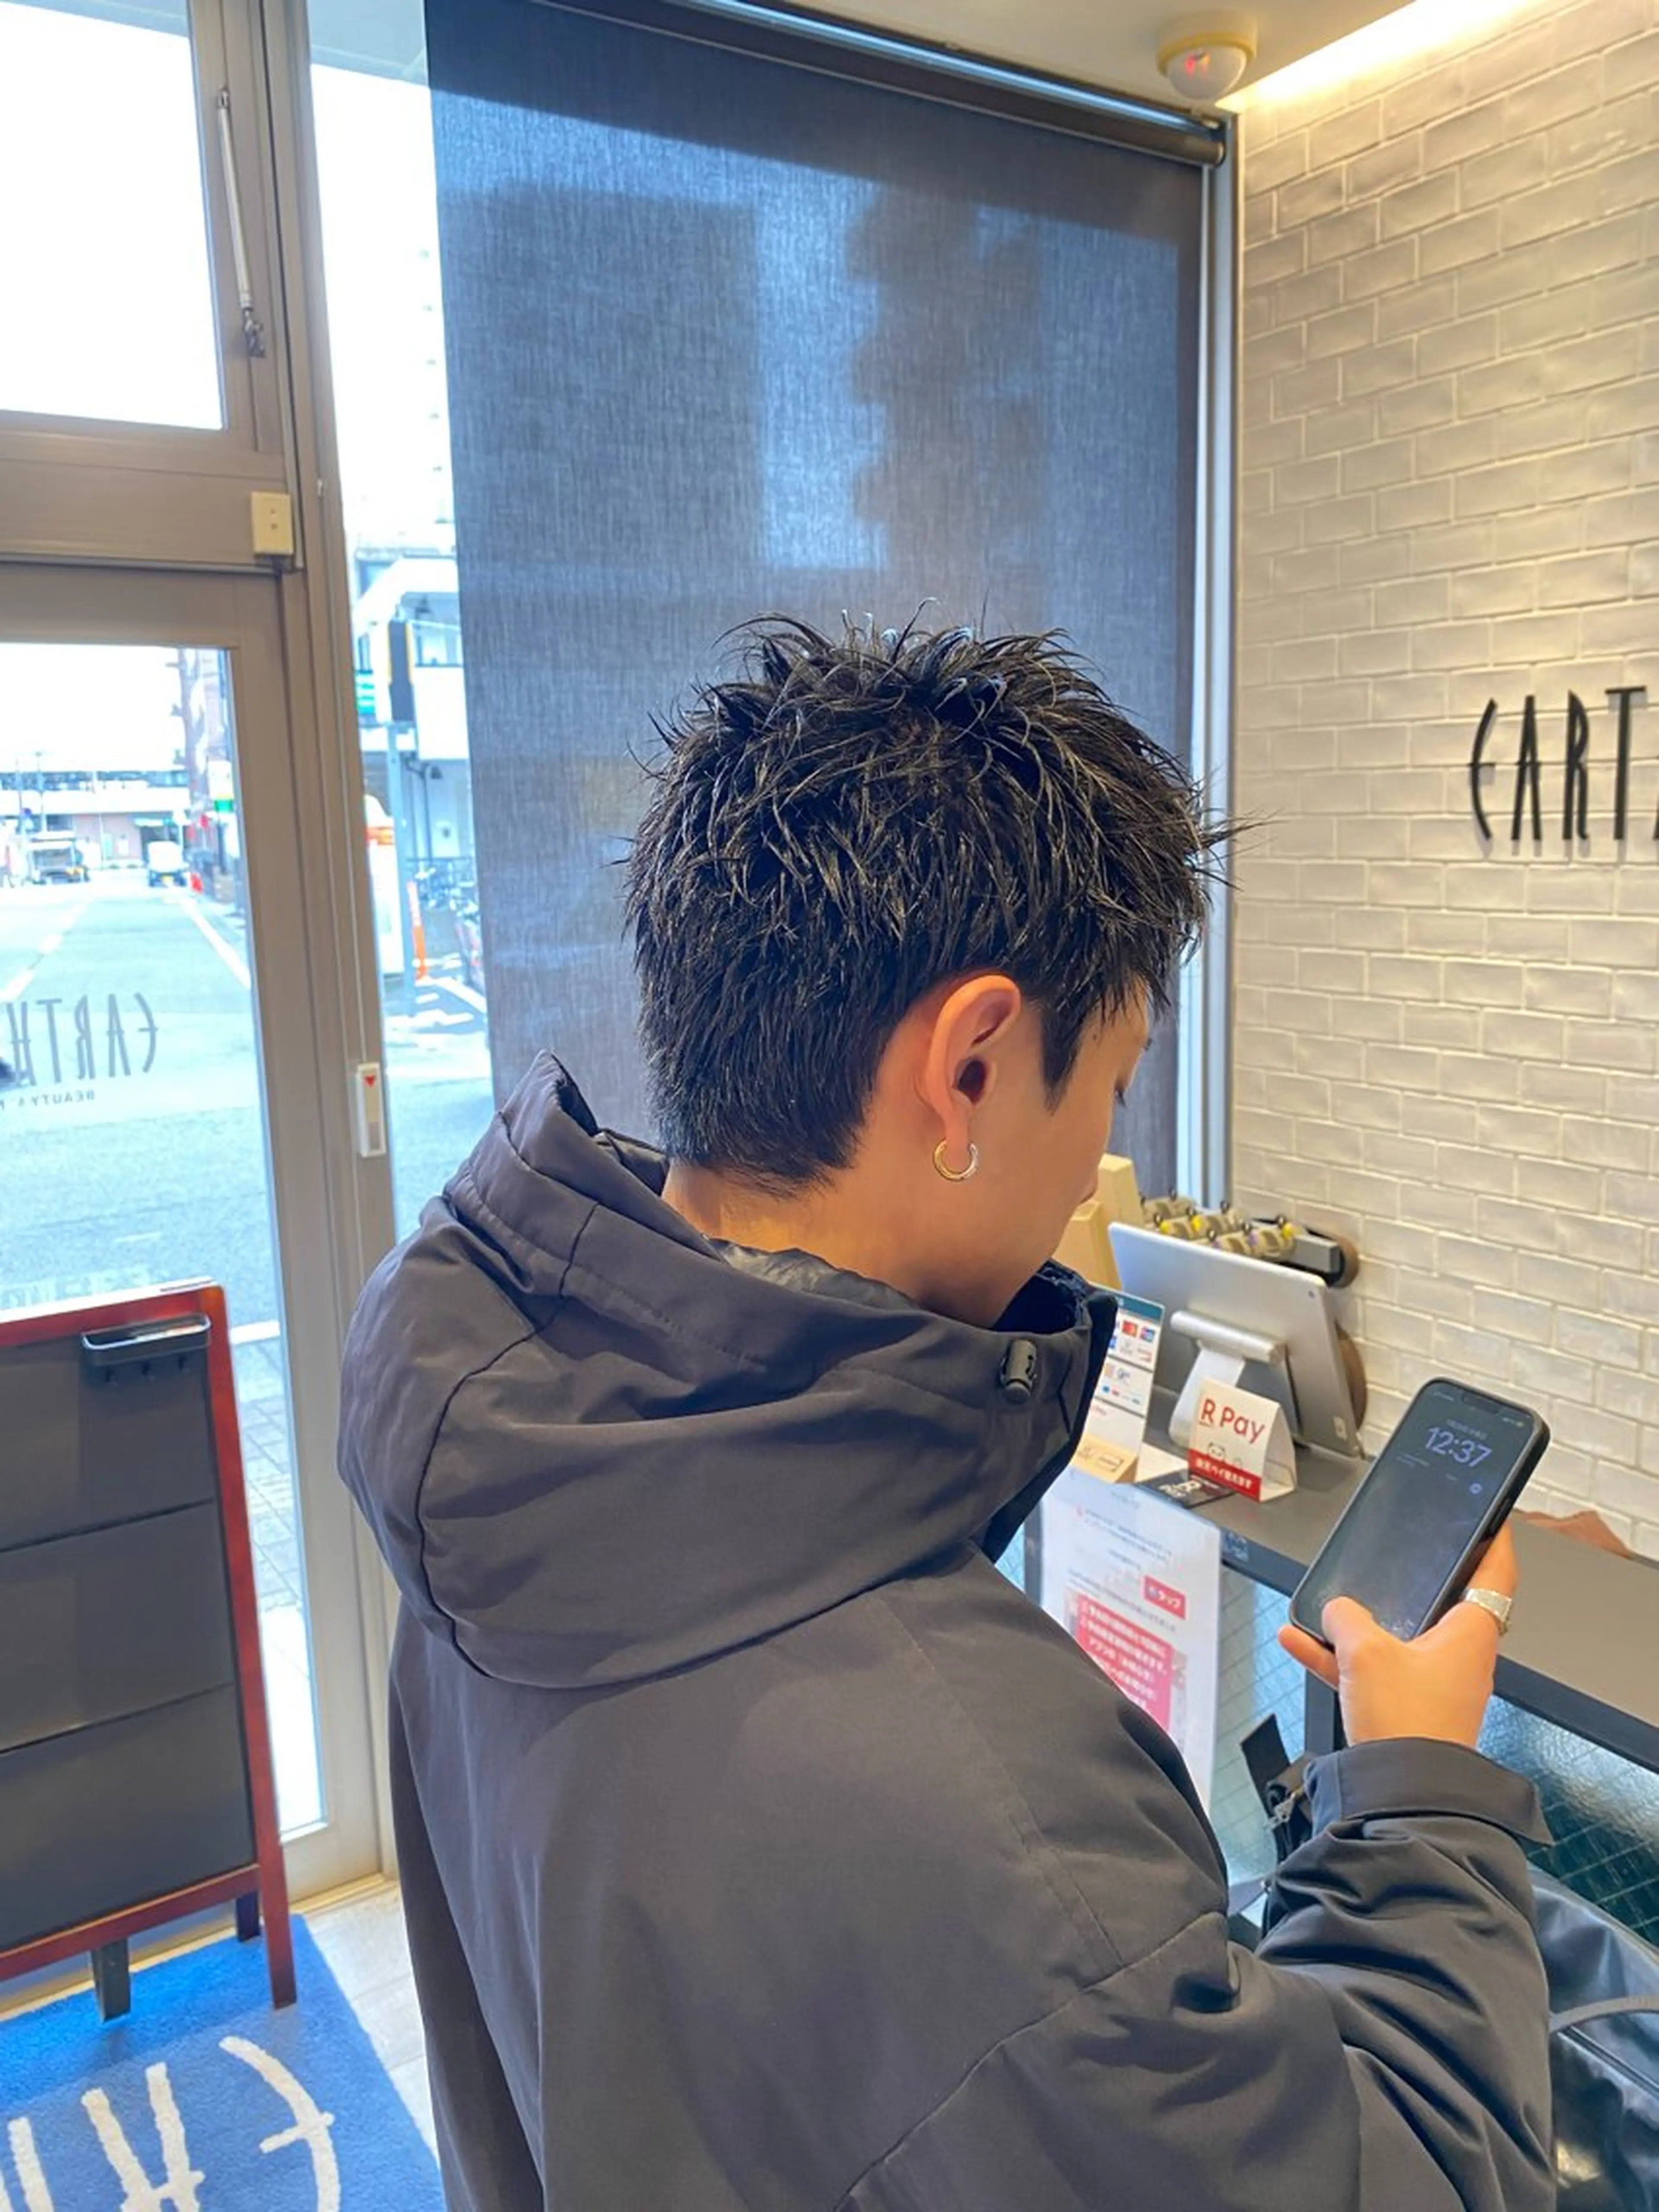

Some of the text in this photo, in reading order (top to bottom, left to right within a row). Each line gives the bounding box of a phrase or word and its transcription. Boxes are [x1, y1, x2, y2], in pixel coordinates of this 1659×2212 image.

[1467, 686, 1659, 840] EART
[1220, 1406, 1265, 1444] Pay
[1426, 1427, 1493, 1467] 12:37
